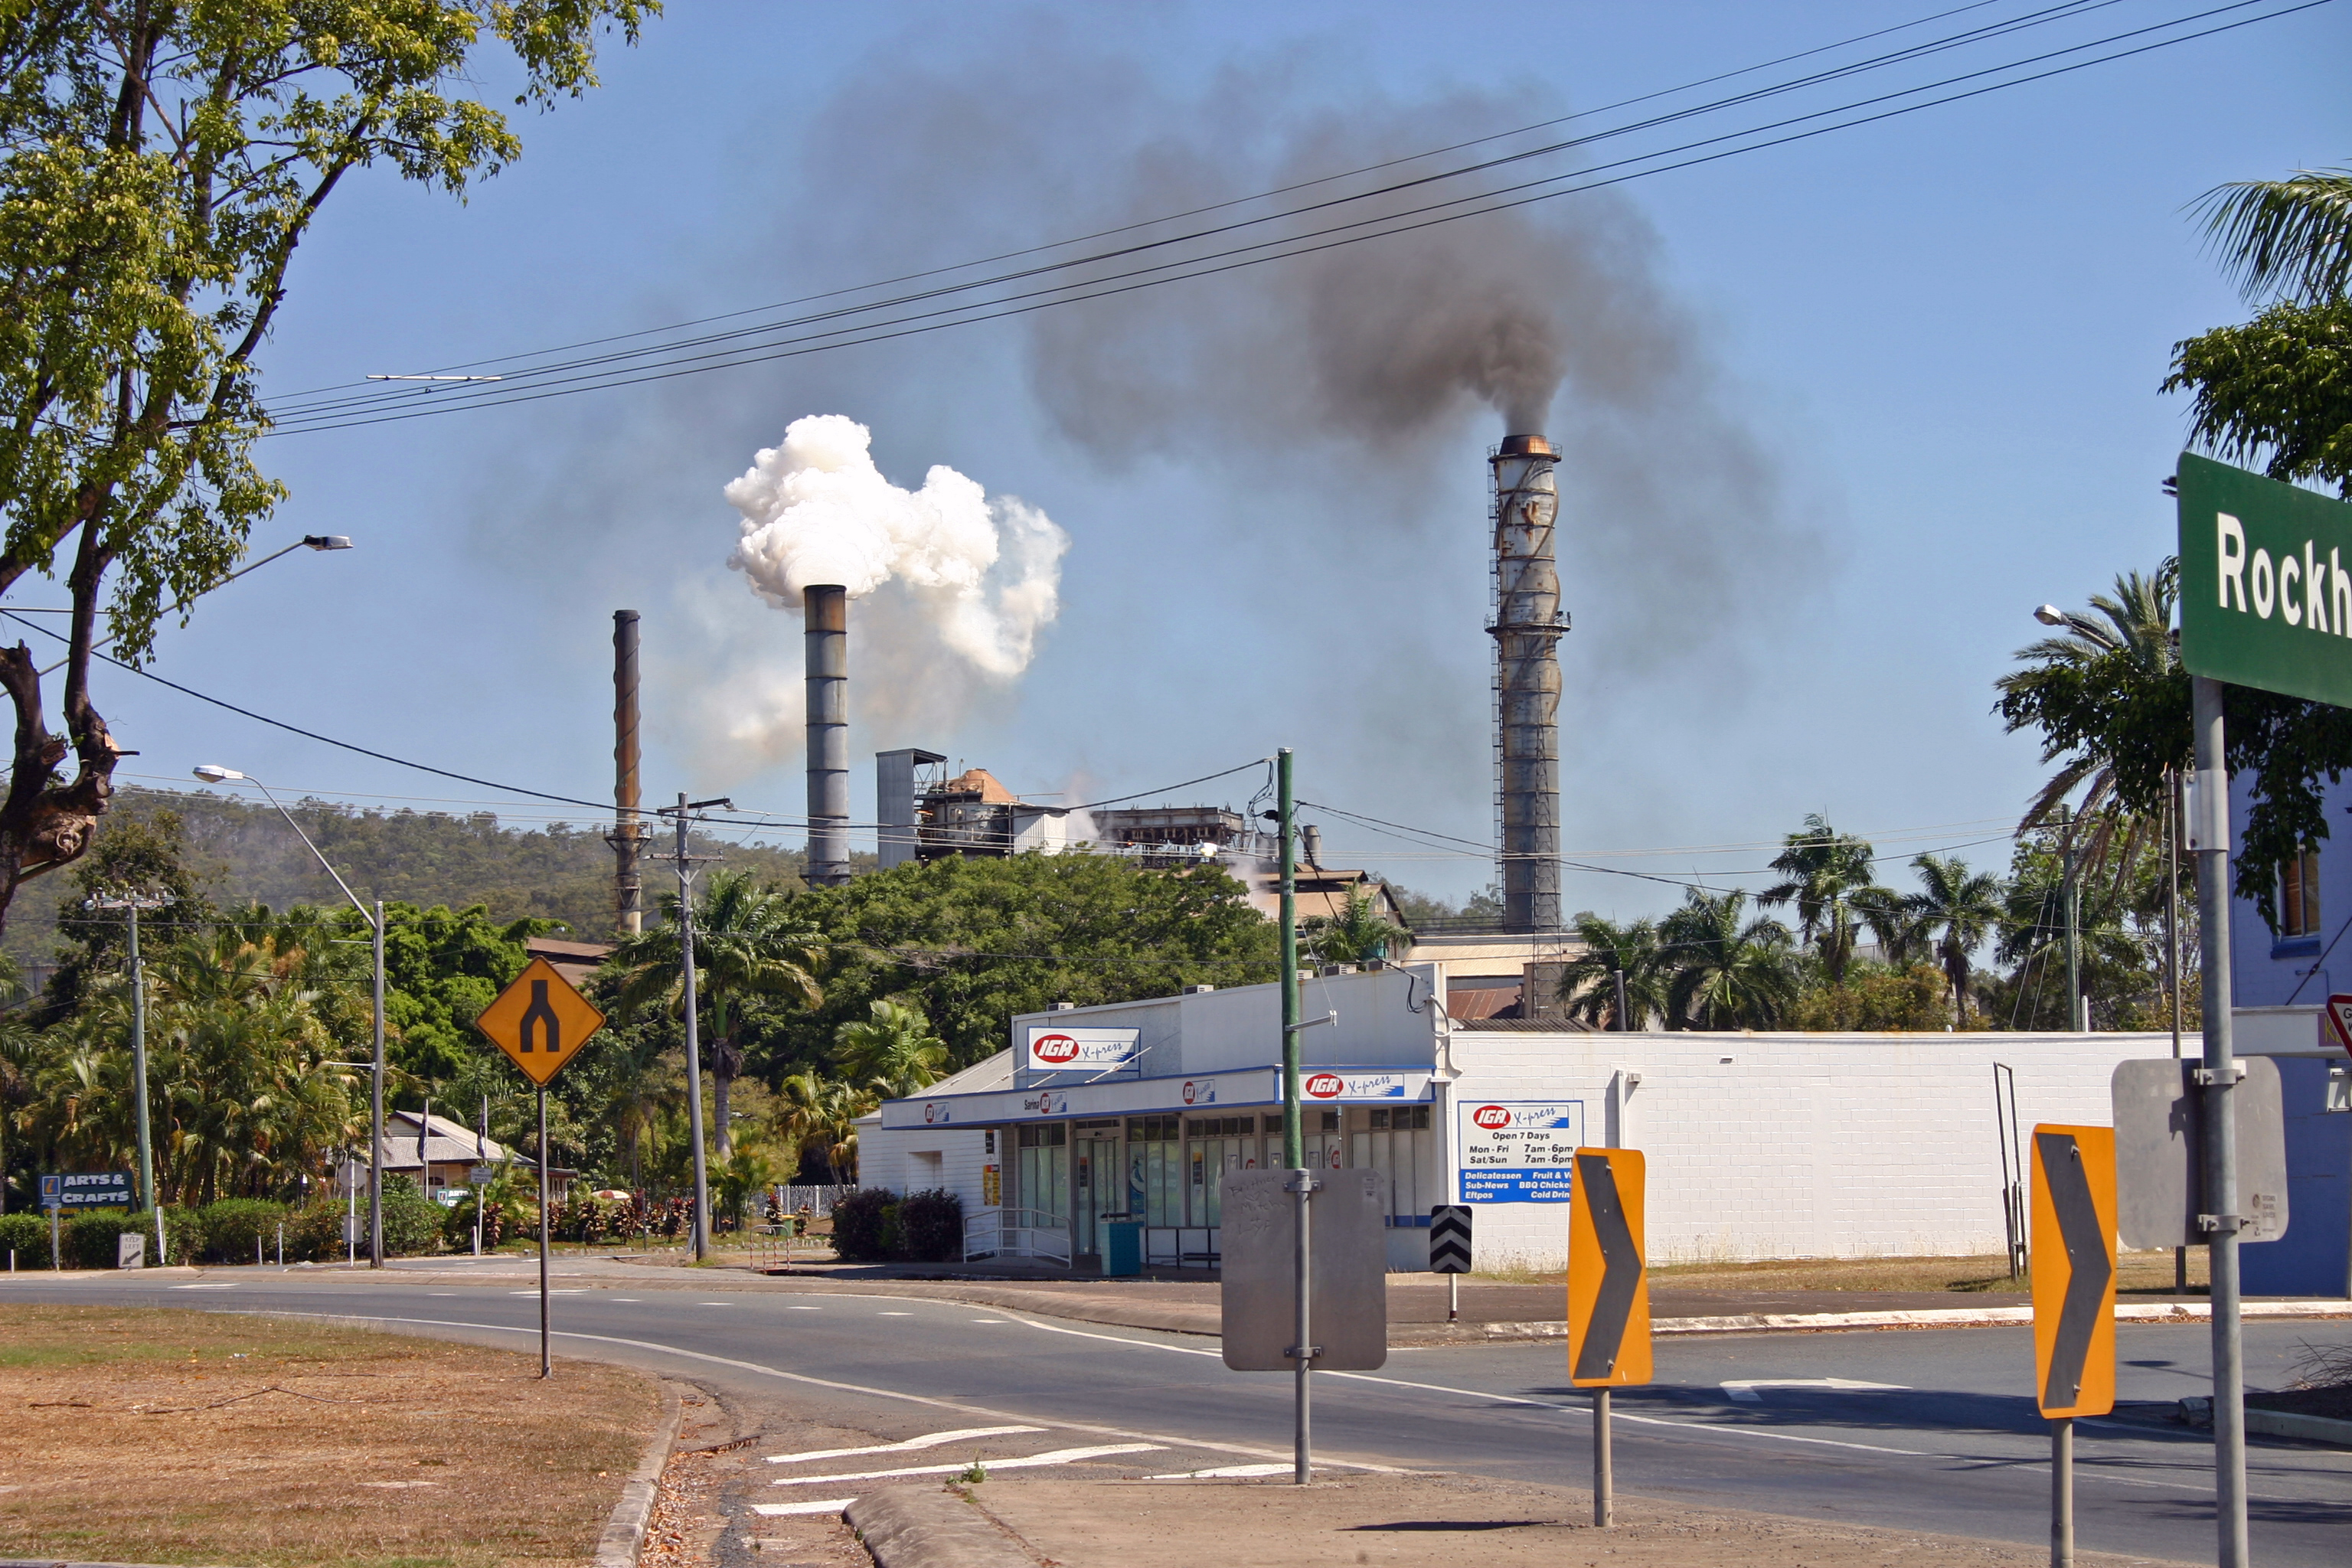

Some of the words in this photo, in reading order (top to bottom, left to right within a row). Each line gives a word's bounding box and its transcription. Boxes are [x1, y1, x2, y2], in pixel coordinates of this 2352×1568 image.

[2217, 511, 2352, 639] Rockh
[1038, 1039, 1074, 1057] IGA
[1082, 1041, 1123, 1060] X-press
[1310, 1078, 1339, 1093] IGA
[1348, 1075, 1391, 1096] X-press
[1024, 1099, 1039, 1110] Sarina
[1477, 1109, 1507, 1124] IGA
[1514, 1107, 1557, 1127] X-press
[1492, 1132, 1517, 1142] Open
[1527, 1132, 1550, 1141] Days
[1524, 1144, 1546, 1152] 7am
[1469, 1155, 1508, 1164] Sat/Sun
[1524, 1155, 1546, 1163] 7am
[64, 1174, 110, 1187] ARTS
[112, 1174, 125, 1185] &
[1465, 1171, 1522, 1180] Delicatessen
[1533, 1171, 1553, 1180] Fruit
[61, 1191, 129, 1204] CRAFTS
[1465, 1191, 1493, 1200] Eftpos
[1530, 1191, 1551, 1199] Cold
